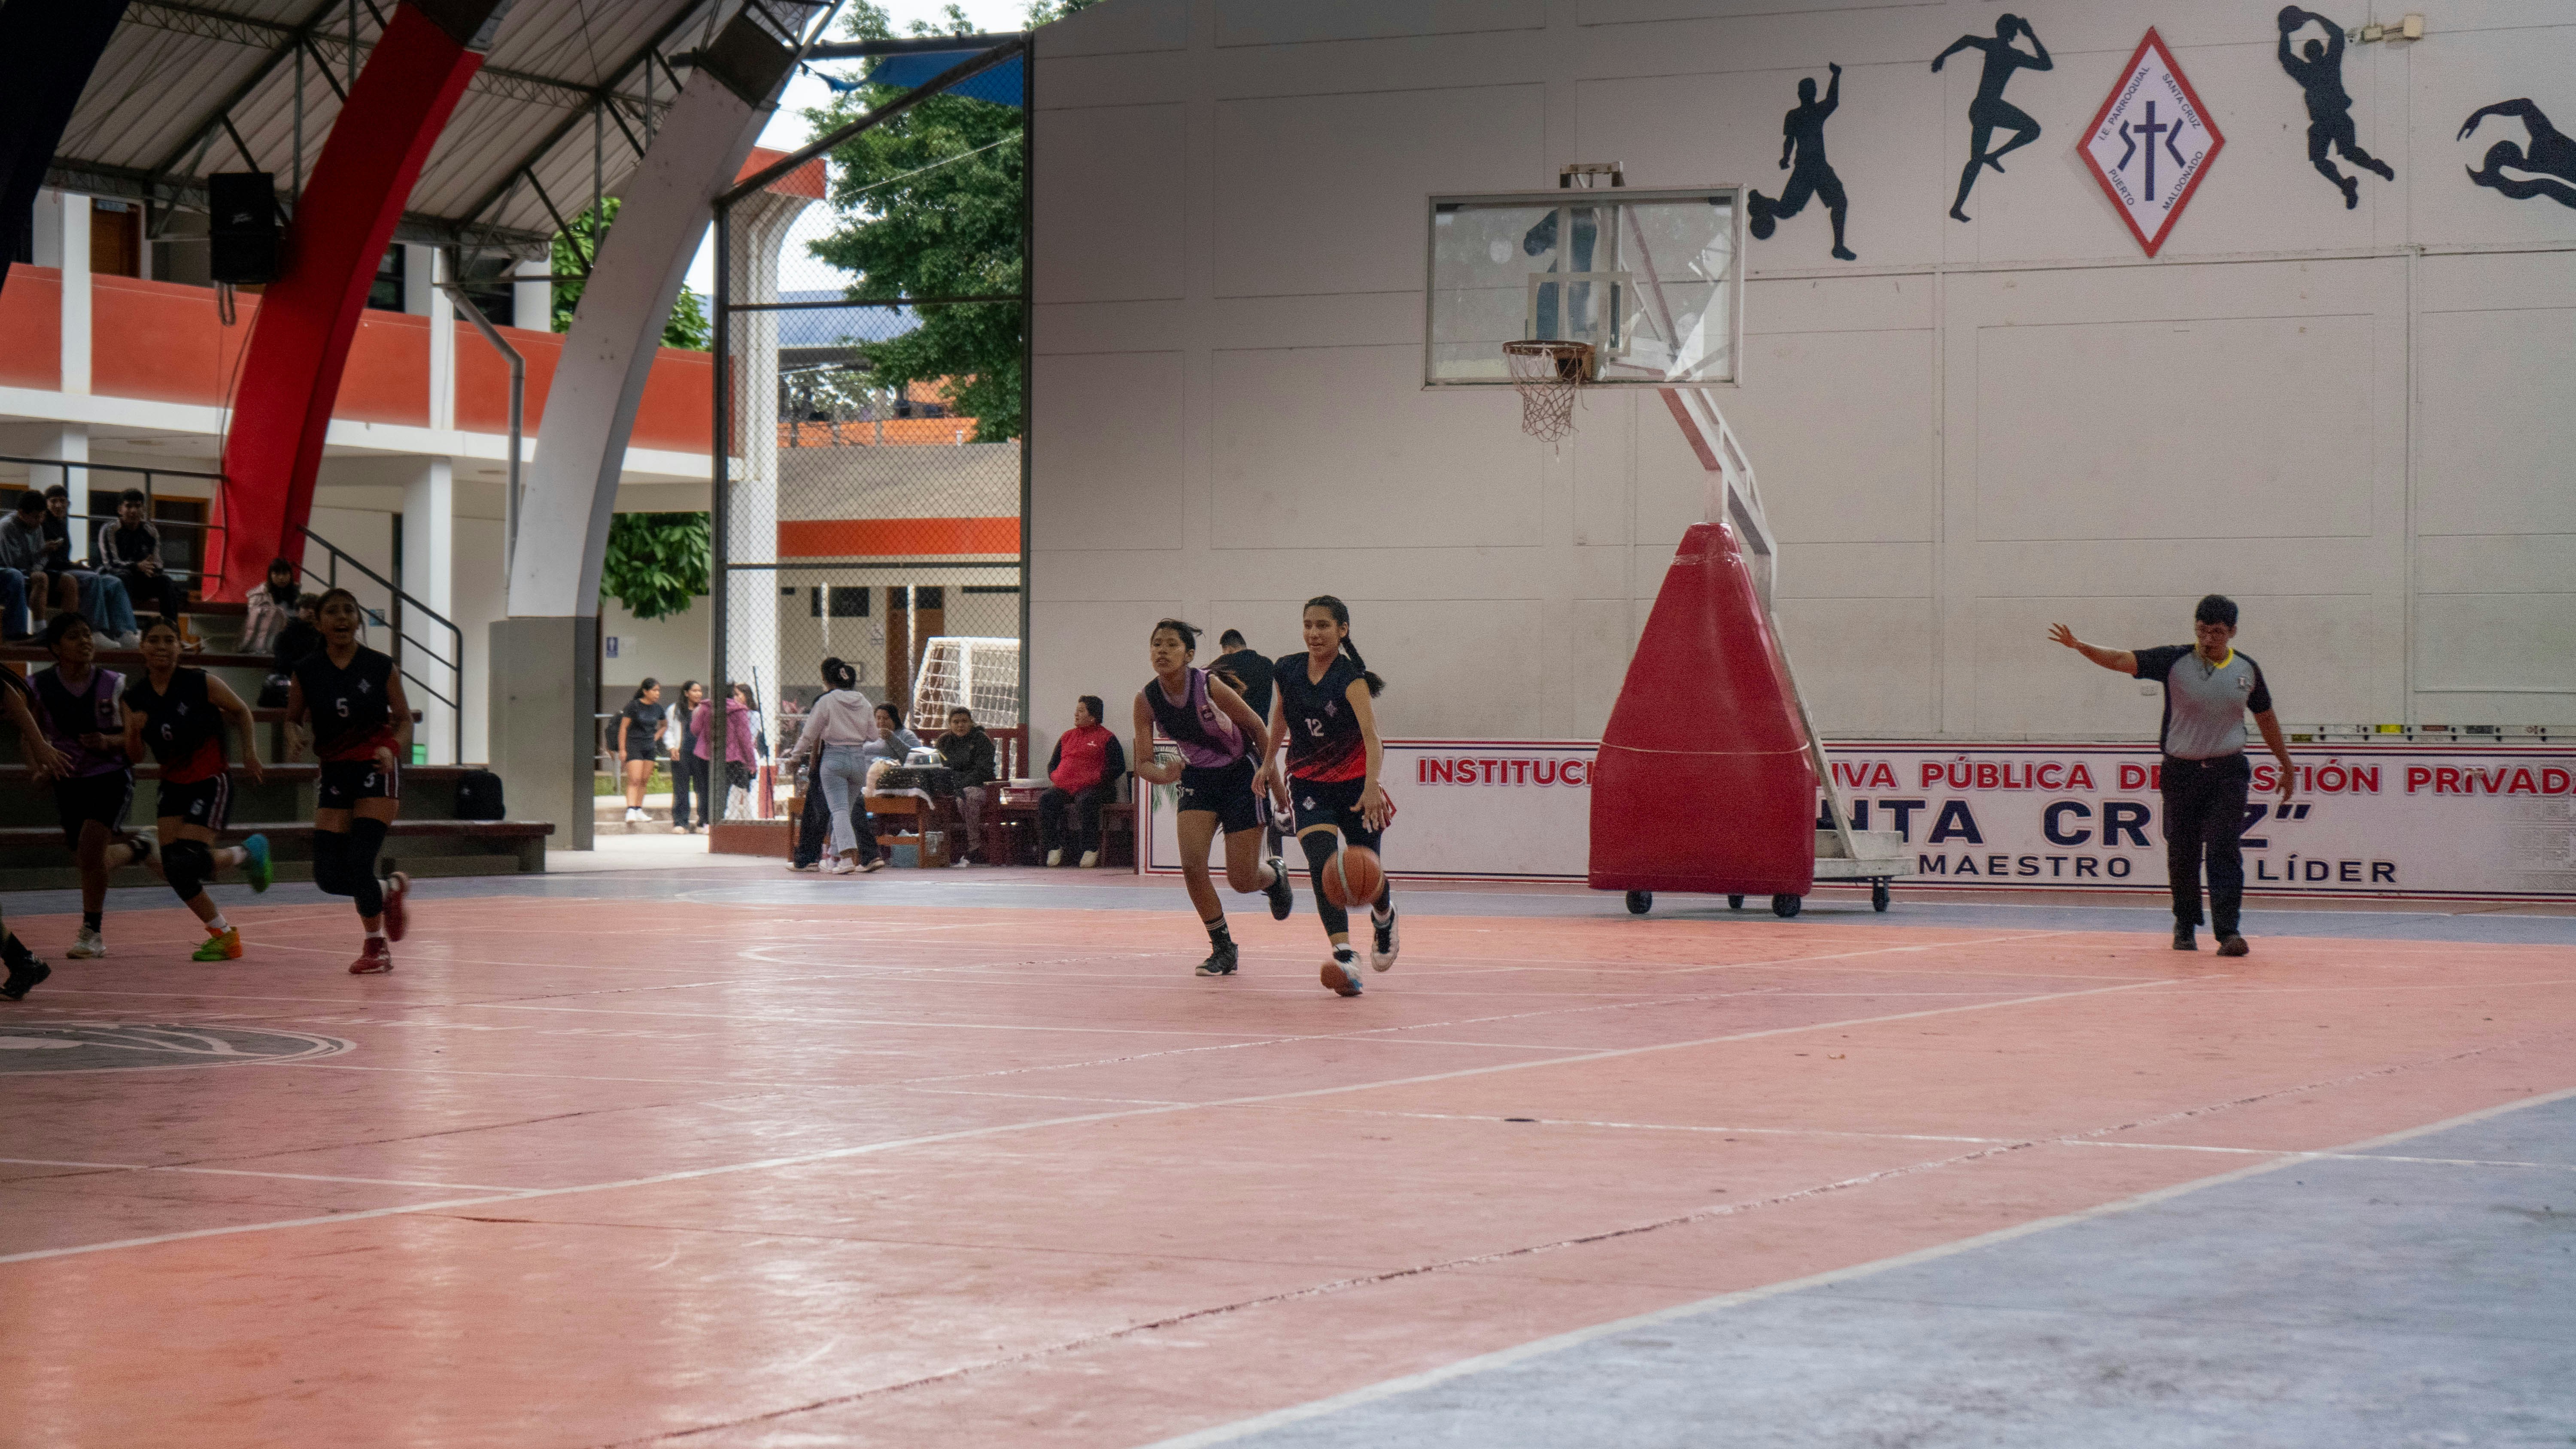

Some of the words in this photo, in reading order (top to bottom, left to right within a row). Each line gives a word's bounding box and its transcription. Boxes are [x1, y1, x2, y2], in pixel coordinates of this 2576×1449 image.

[2108, 67, 2150, 127] PARROQUIAL
[2162, 73, 2184, 105] SANTA
[2181, 100, 2202, 130] CRUZ
[2108, 169, 2135, 206] PUERTO
[2163, 150, 2204, 211] MALDONADO
[336, 697, 349, 718] 5
[161, 722, 173, 741] 6
[1304, 718, 1325, 737] 12
[1921, 756, 2093, 789] PÚBLICA
[2407, 767, 2576, 794] PRIVAD
[1918, 855, 2132, 878] MAESTRO
[2257, 854, 2397, 883] LÍDER
